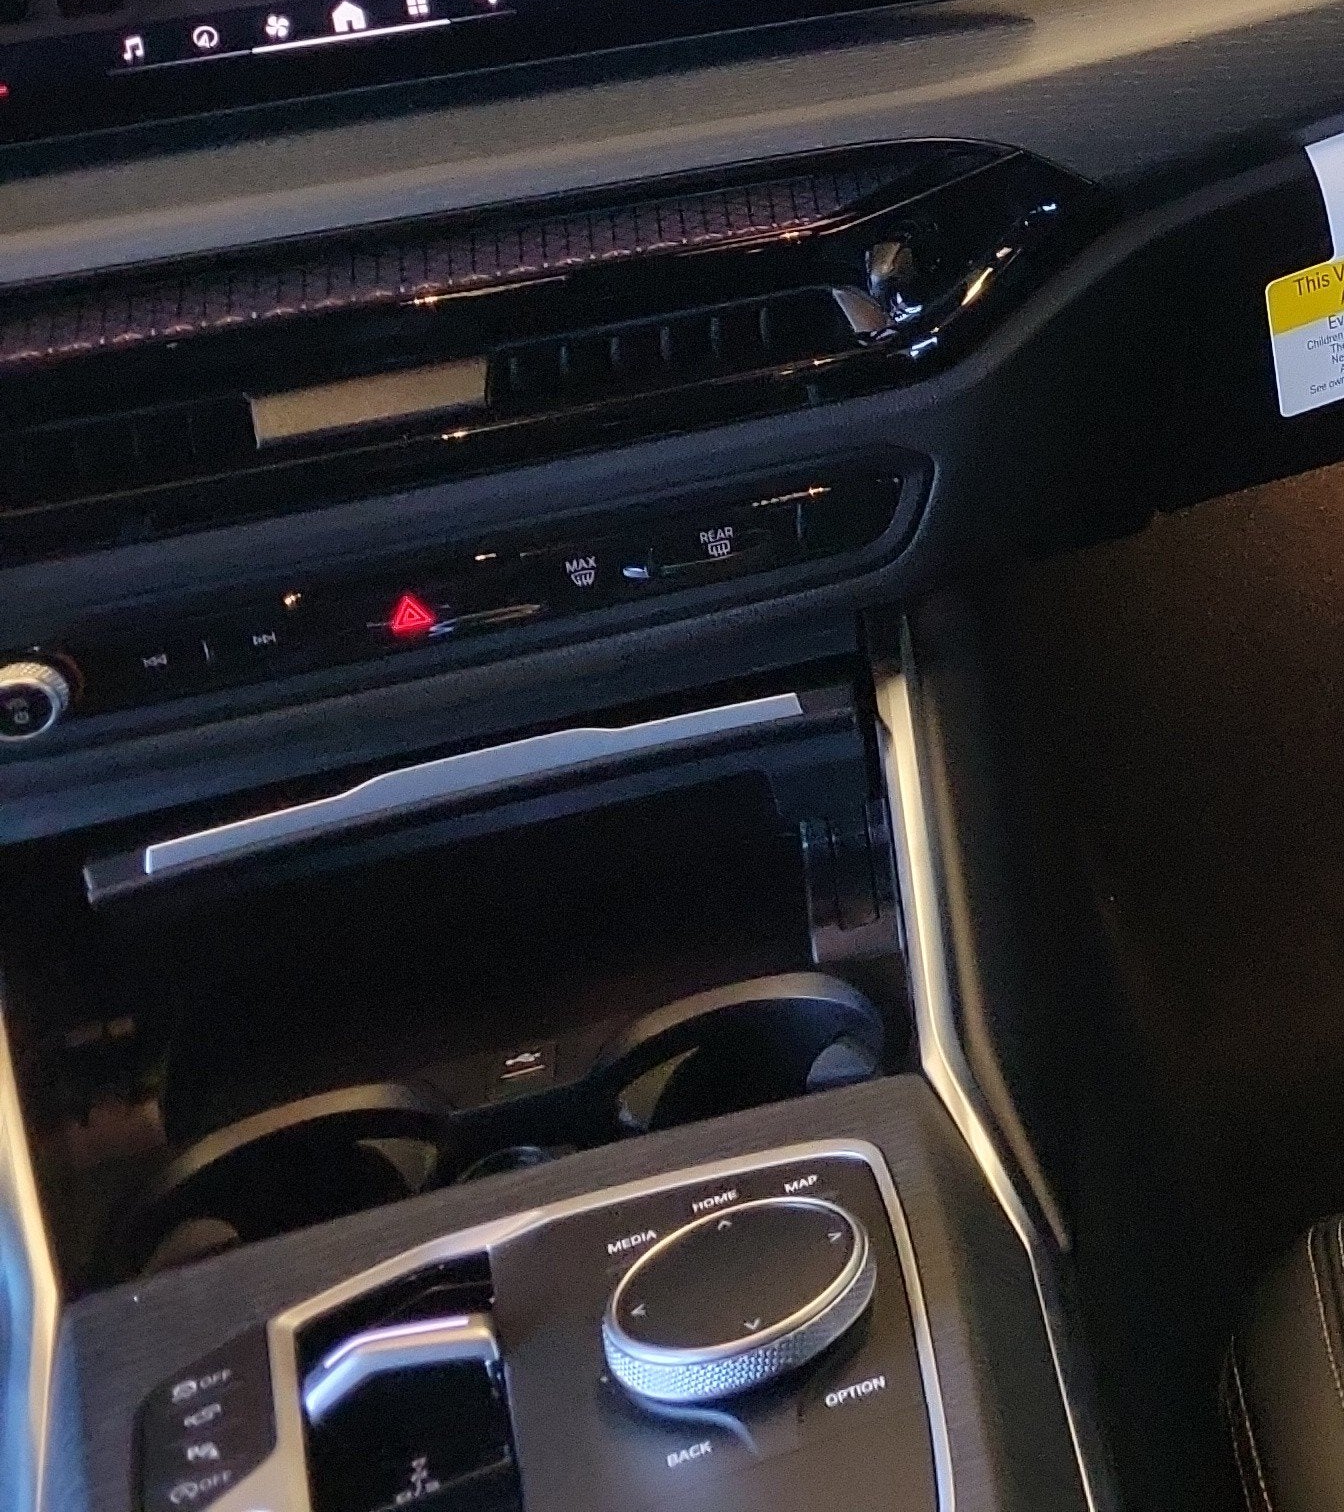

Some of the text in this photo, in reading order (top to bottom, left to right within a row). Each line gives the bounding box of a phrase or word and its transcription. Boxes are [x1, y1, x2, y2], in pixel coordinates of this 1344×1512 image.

[1293, 272, 1330, 296] This
[1307, 332, 1343, 350] Children
[1310, 383, 1327, 395] See
[699, 527, 733, 543] REAR
[565, 556, 596, 573] MAX
[784, 1174, 818, 1193] MAP
[692, 1189, 739, 1213] HOME
[607, 1229, 657, 1254] MEDIA
[825, 1375, 885, 1407] OPTION
[666, 1441, 712, 1468] BACK
